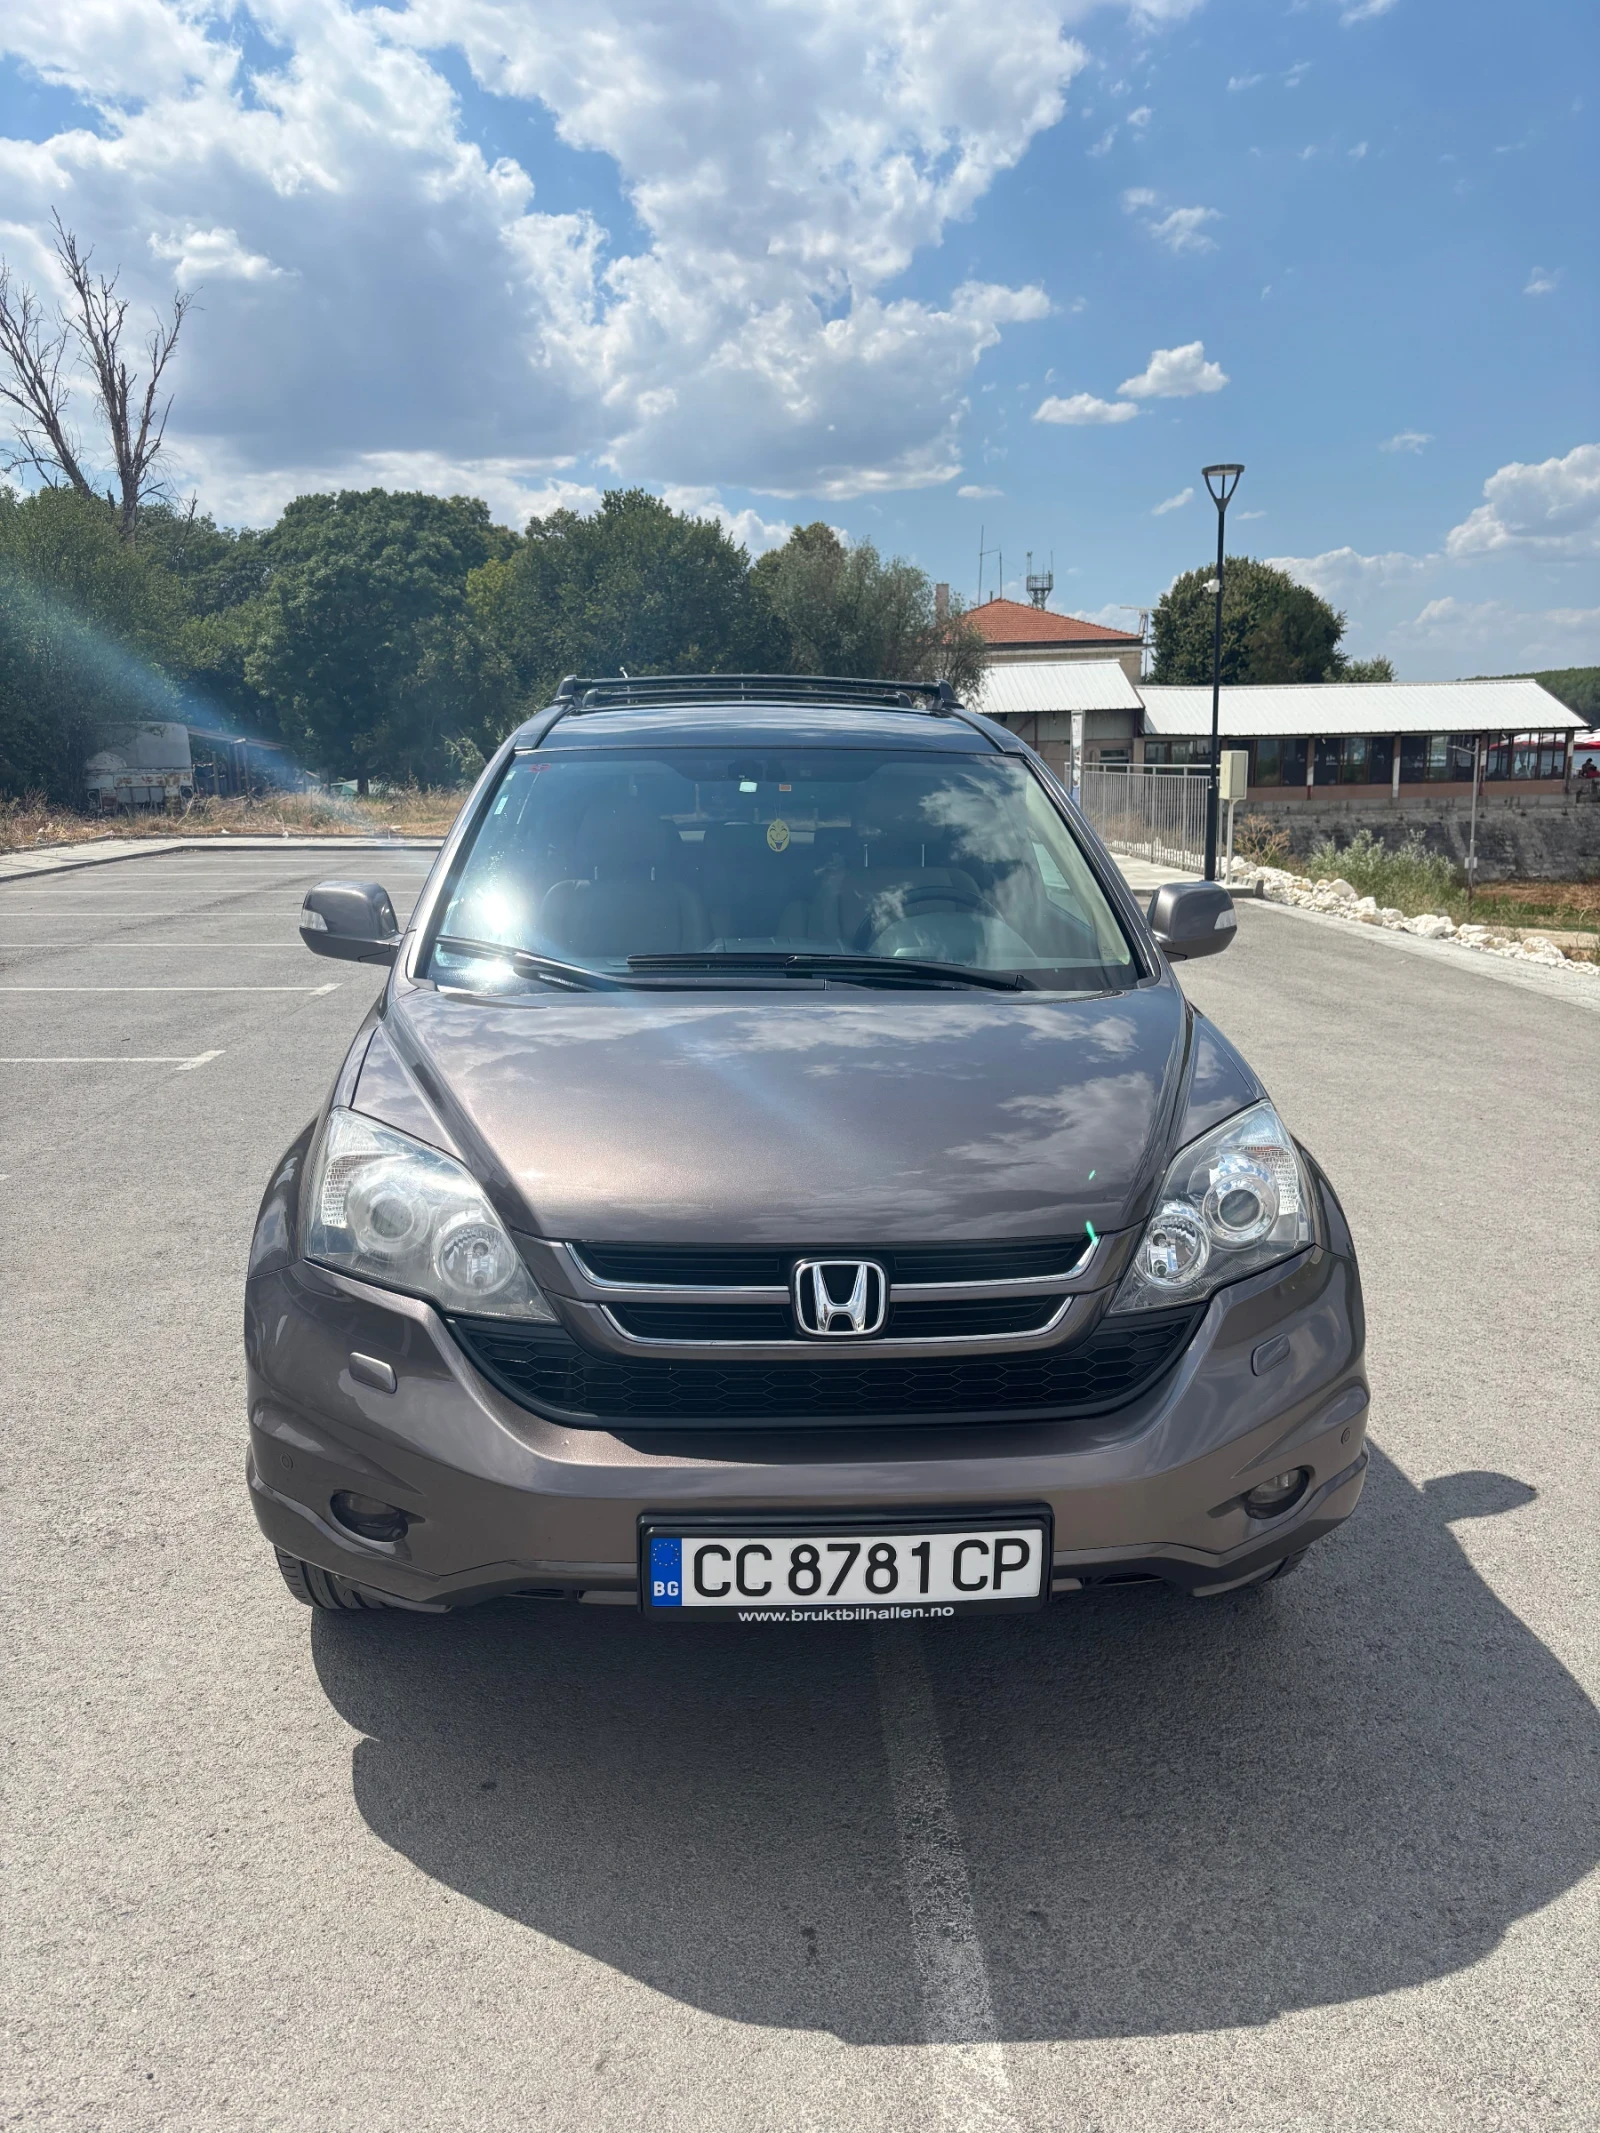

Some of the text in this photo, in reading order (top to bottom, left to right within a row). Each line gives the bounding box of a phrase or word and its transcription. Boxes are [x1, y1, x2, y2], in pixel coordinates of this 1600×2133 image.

[693, 1537, 1030, 1598] CC 8781 CP
[652, 1580, 679, 1597] BG
[738, 1604, 955, 1622] www.bruktbilhallen.no
